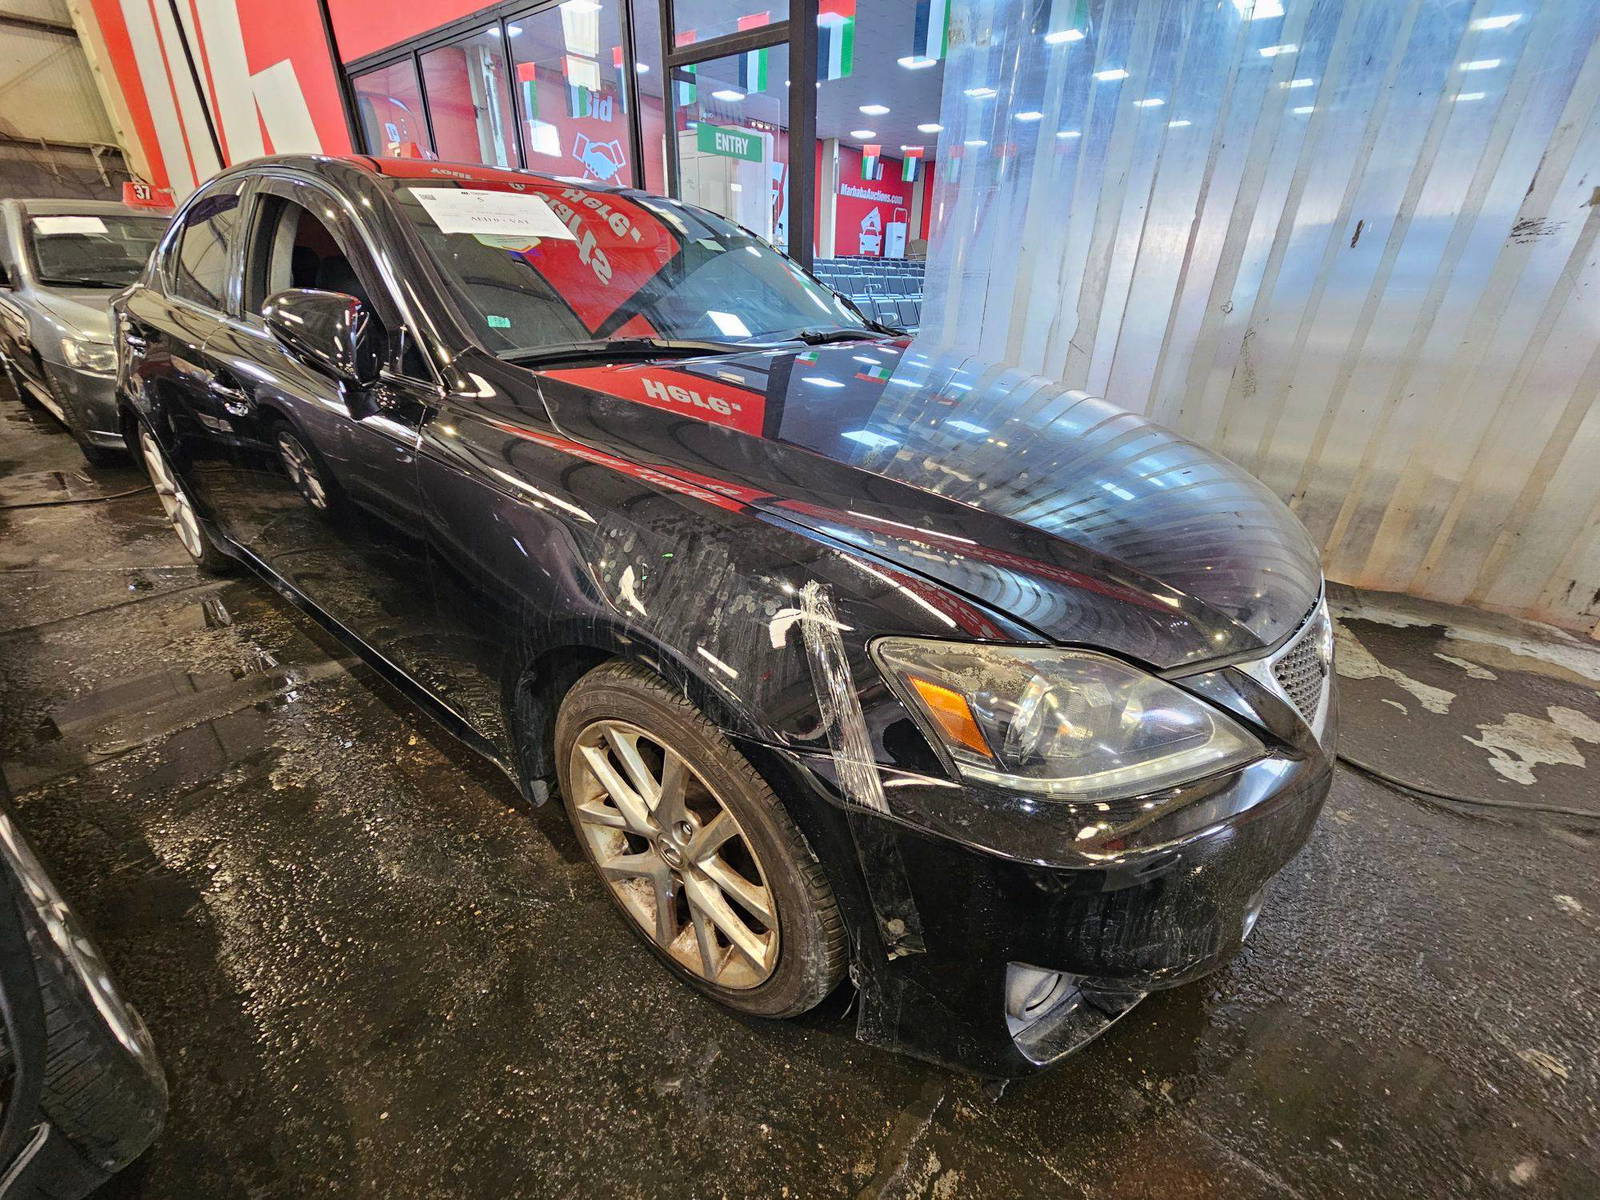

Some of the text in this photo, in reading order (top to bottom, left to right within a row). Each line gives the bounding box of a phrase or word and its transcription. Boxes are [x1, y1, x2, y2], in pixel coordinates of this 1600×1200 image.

[715, 132, 749, 155] ENTRY
[133, 184, 152, 200] 37
[840, 183, 904, 205] MarhabaAuctions.com
